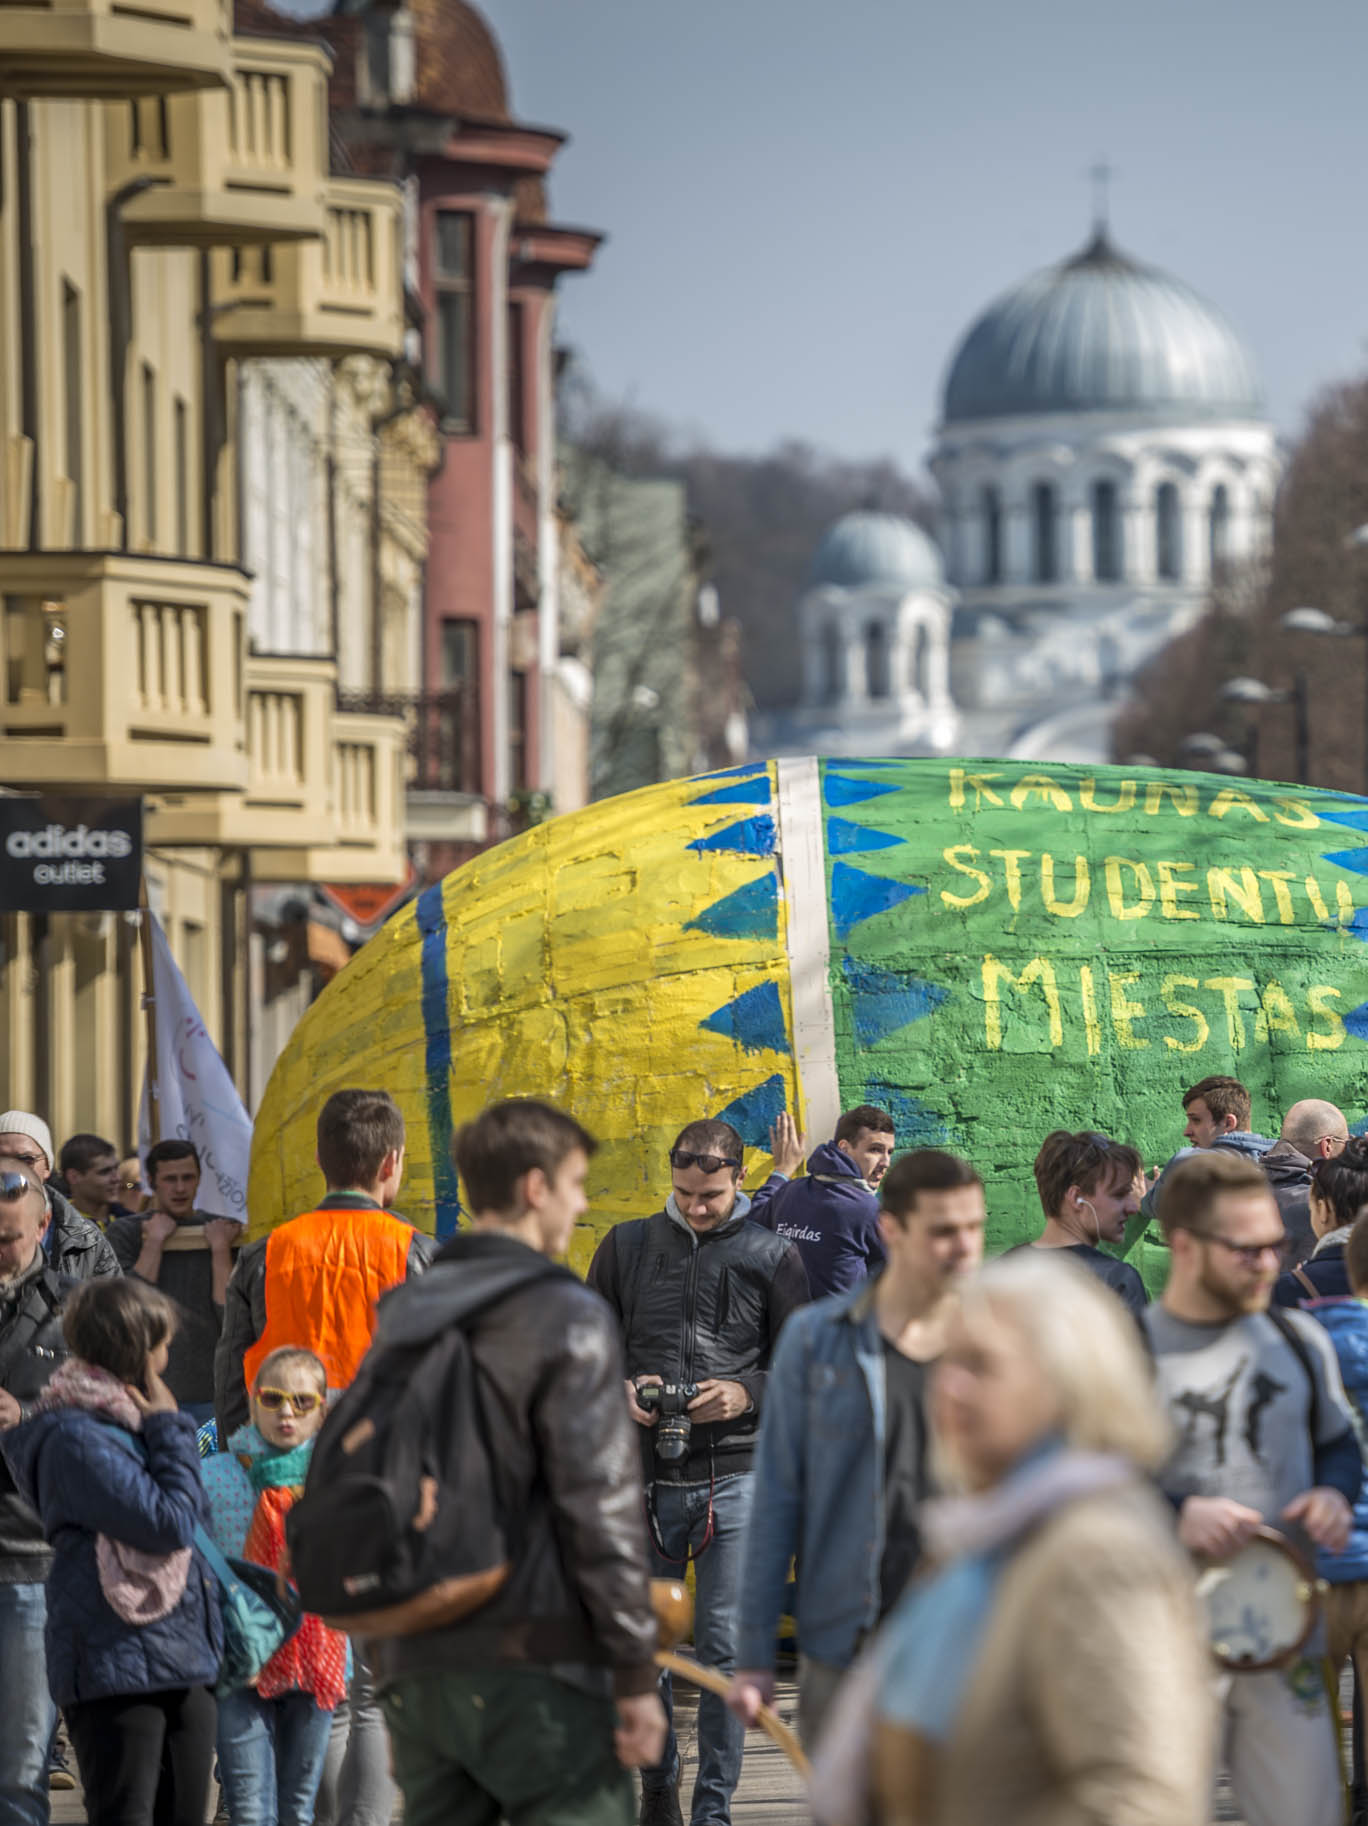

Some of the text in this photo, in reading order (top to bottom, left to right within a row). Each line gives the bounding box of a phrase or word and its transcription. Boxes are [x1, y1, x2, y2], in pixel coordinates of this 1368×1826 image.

[949, 768, 1320, 829] KAUNAS
[6, 824, 132, 858] adidas
[33, 860, 106, 885] outlet
[981, 954, 1347, 1055] MIESTAS
